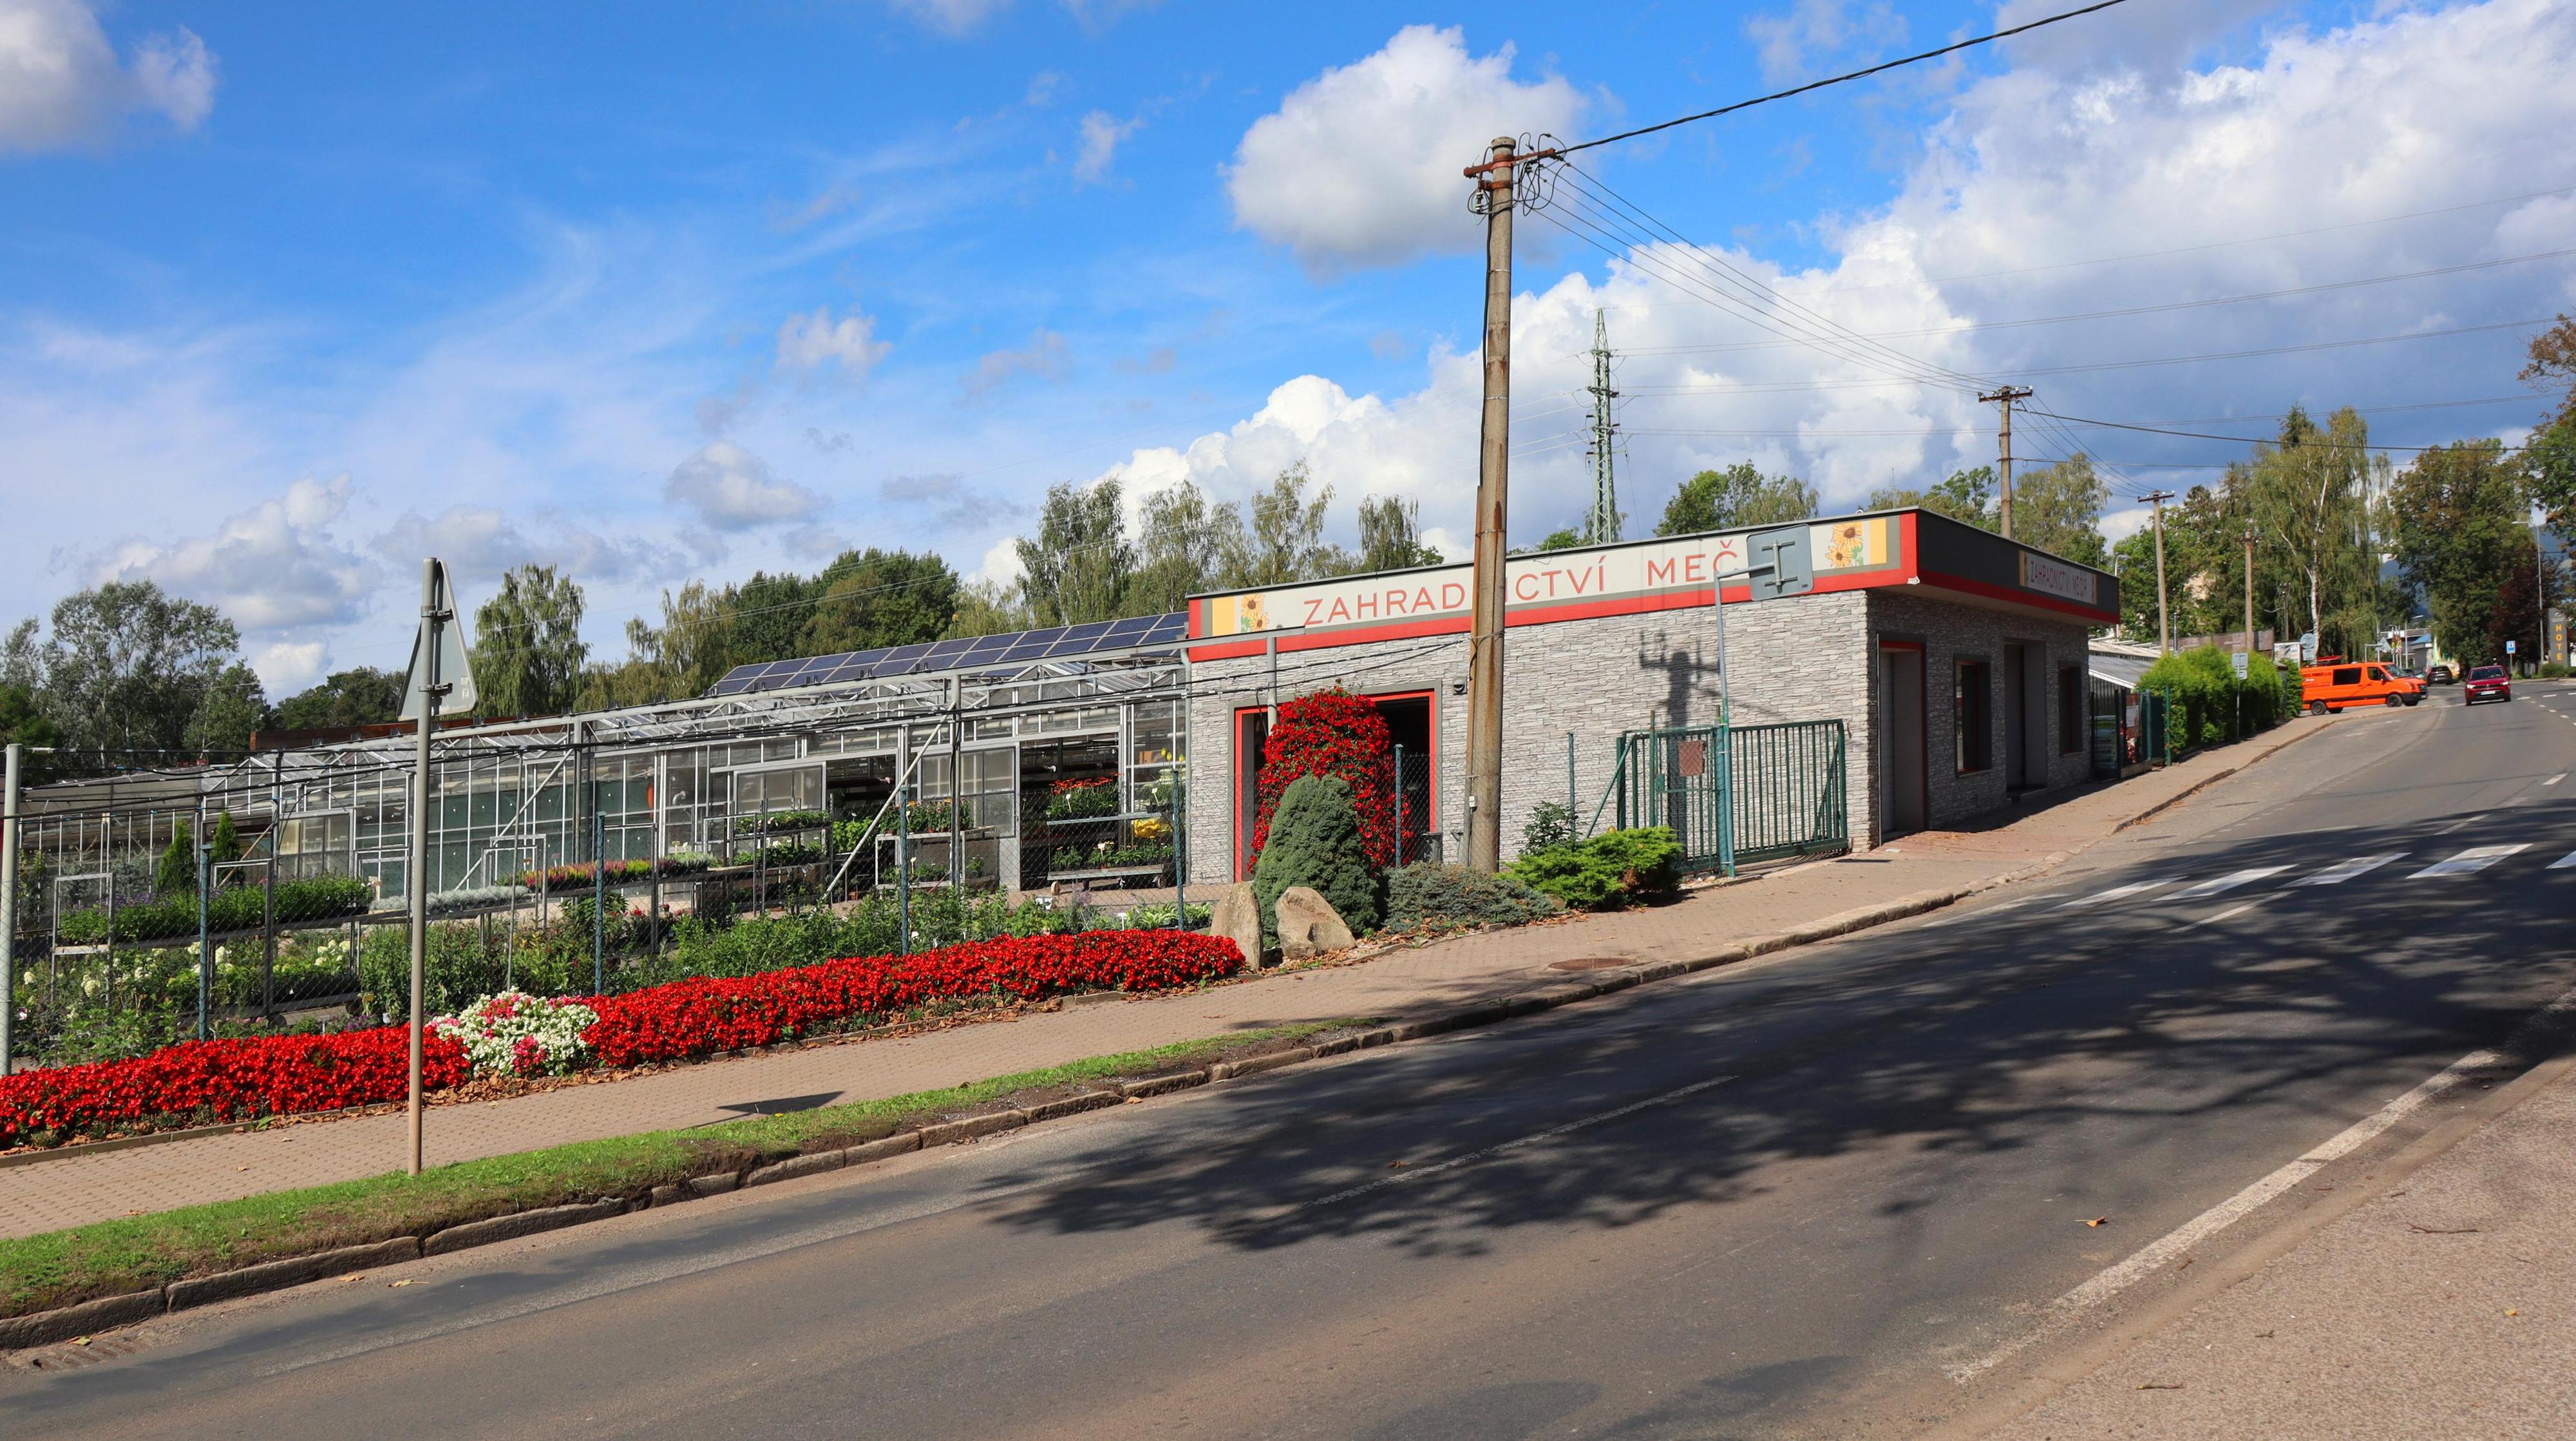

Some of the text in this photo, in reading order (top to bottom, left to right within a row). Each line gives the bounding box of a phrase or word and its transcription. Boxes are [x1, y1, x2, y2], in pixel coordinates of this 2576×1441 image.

[1303, 539, 1738, 625] ZAHRADICTVÍ MEČ
[2555, 624, 2563, 660] HOTE
